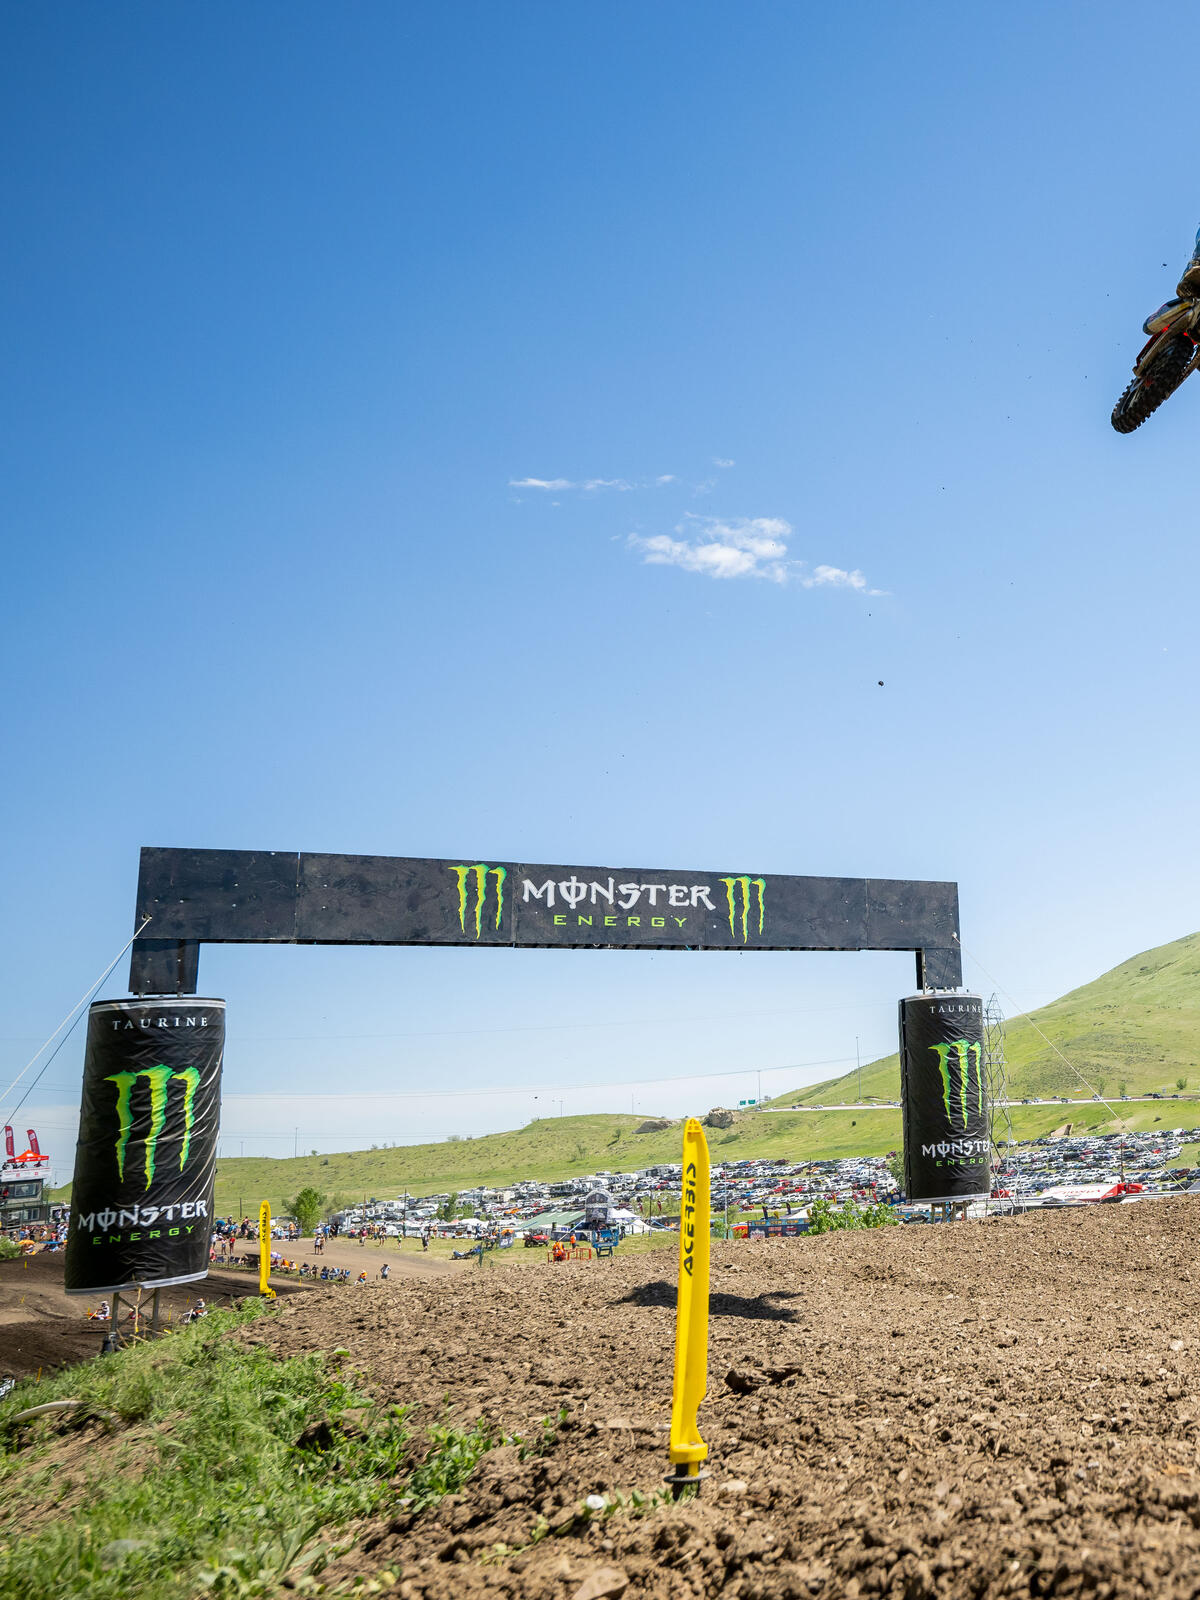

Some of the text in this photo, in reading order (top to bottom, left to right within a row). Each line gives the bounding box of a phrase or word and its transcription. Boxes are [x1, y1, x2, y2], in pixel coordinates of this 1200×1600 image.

[522, 876, 716, 910] MONSTER
[554, 914, 688, 928] ENERGY
[112, 1017, 208, 1031] TAURINE
[921, 1139, 990, 1159] MONSTE
[78, 1200, 208, 1232] MONSTER
[92, 1225, 194, 1245] ENERGY
